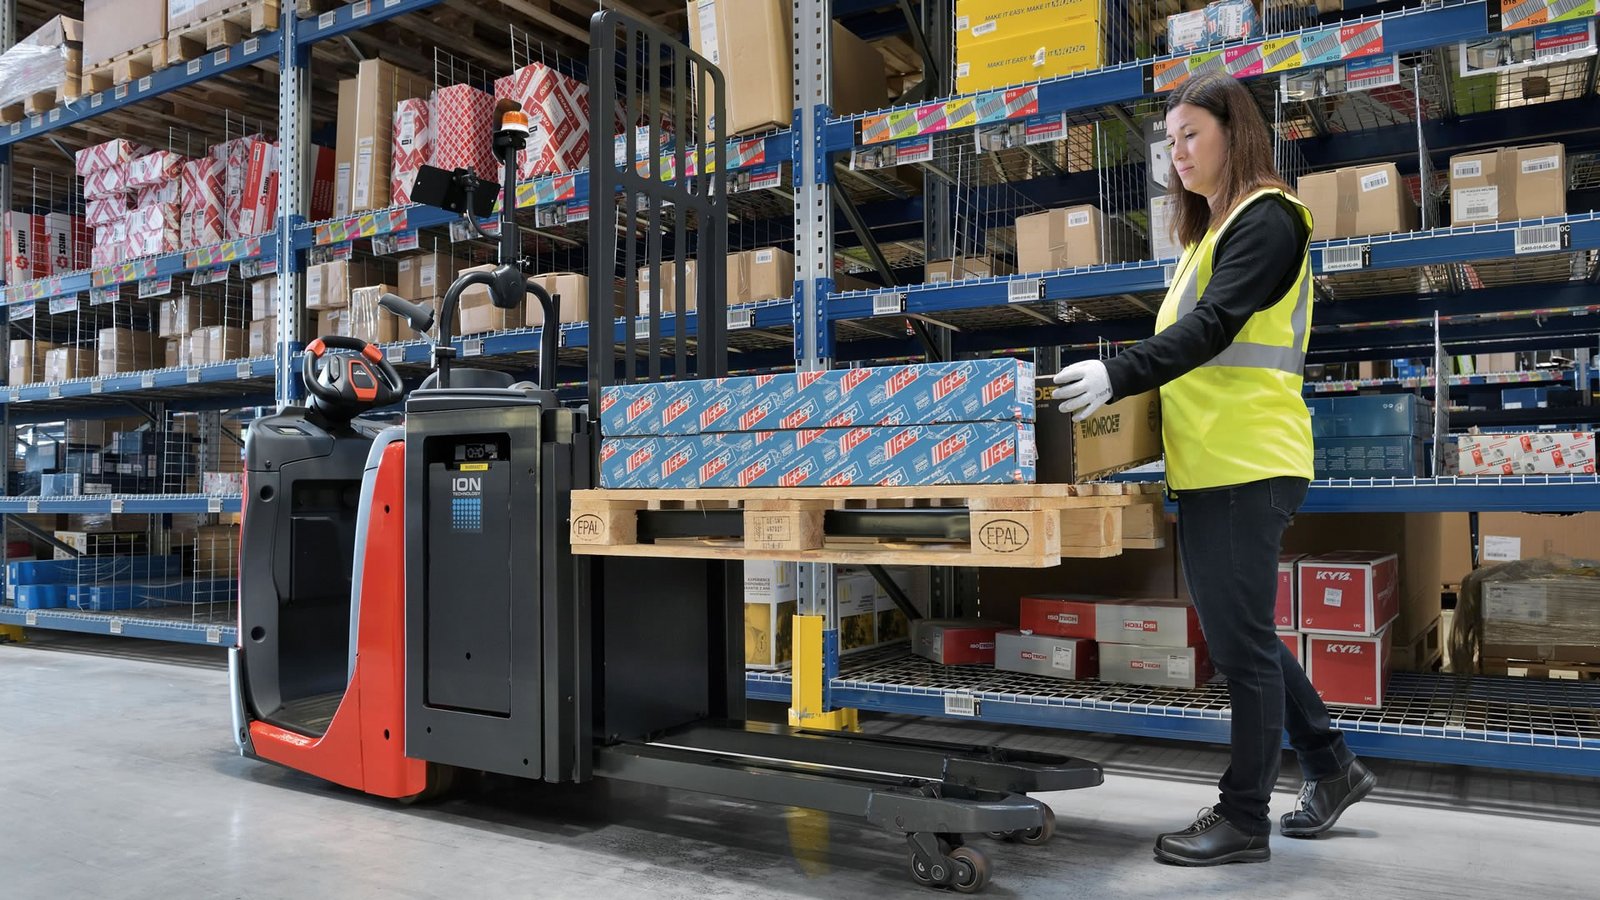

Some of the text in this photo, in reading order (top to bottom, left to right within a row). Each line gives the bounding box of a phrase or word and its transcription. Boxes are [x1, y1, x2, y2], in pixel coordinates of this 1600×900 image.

[985, 12, 1001, 21] MAKE
[1026, 5, 1040, 13] MAKE
[1342, 28, 1355, 36] 018
[1264, 43, 1276, 51] 018
[1085, 414, 1117, 437] MONROE
[452, 477, 481, 491] ION
[577, 520, 600, 535] EPAL
[986, 527, 1022, 545] EPAL
[1316, 570, 1352, 581] KYB
[1326, 643, 1362, 654] KYB
